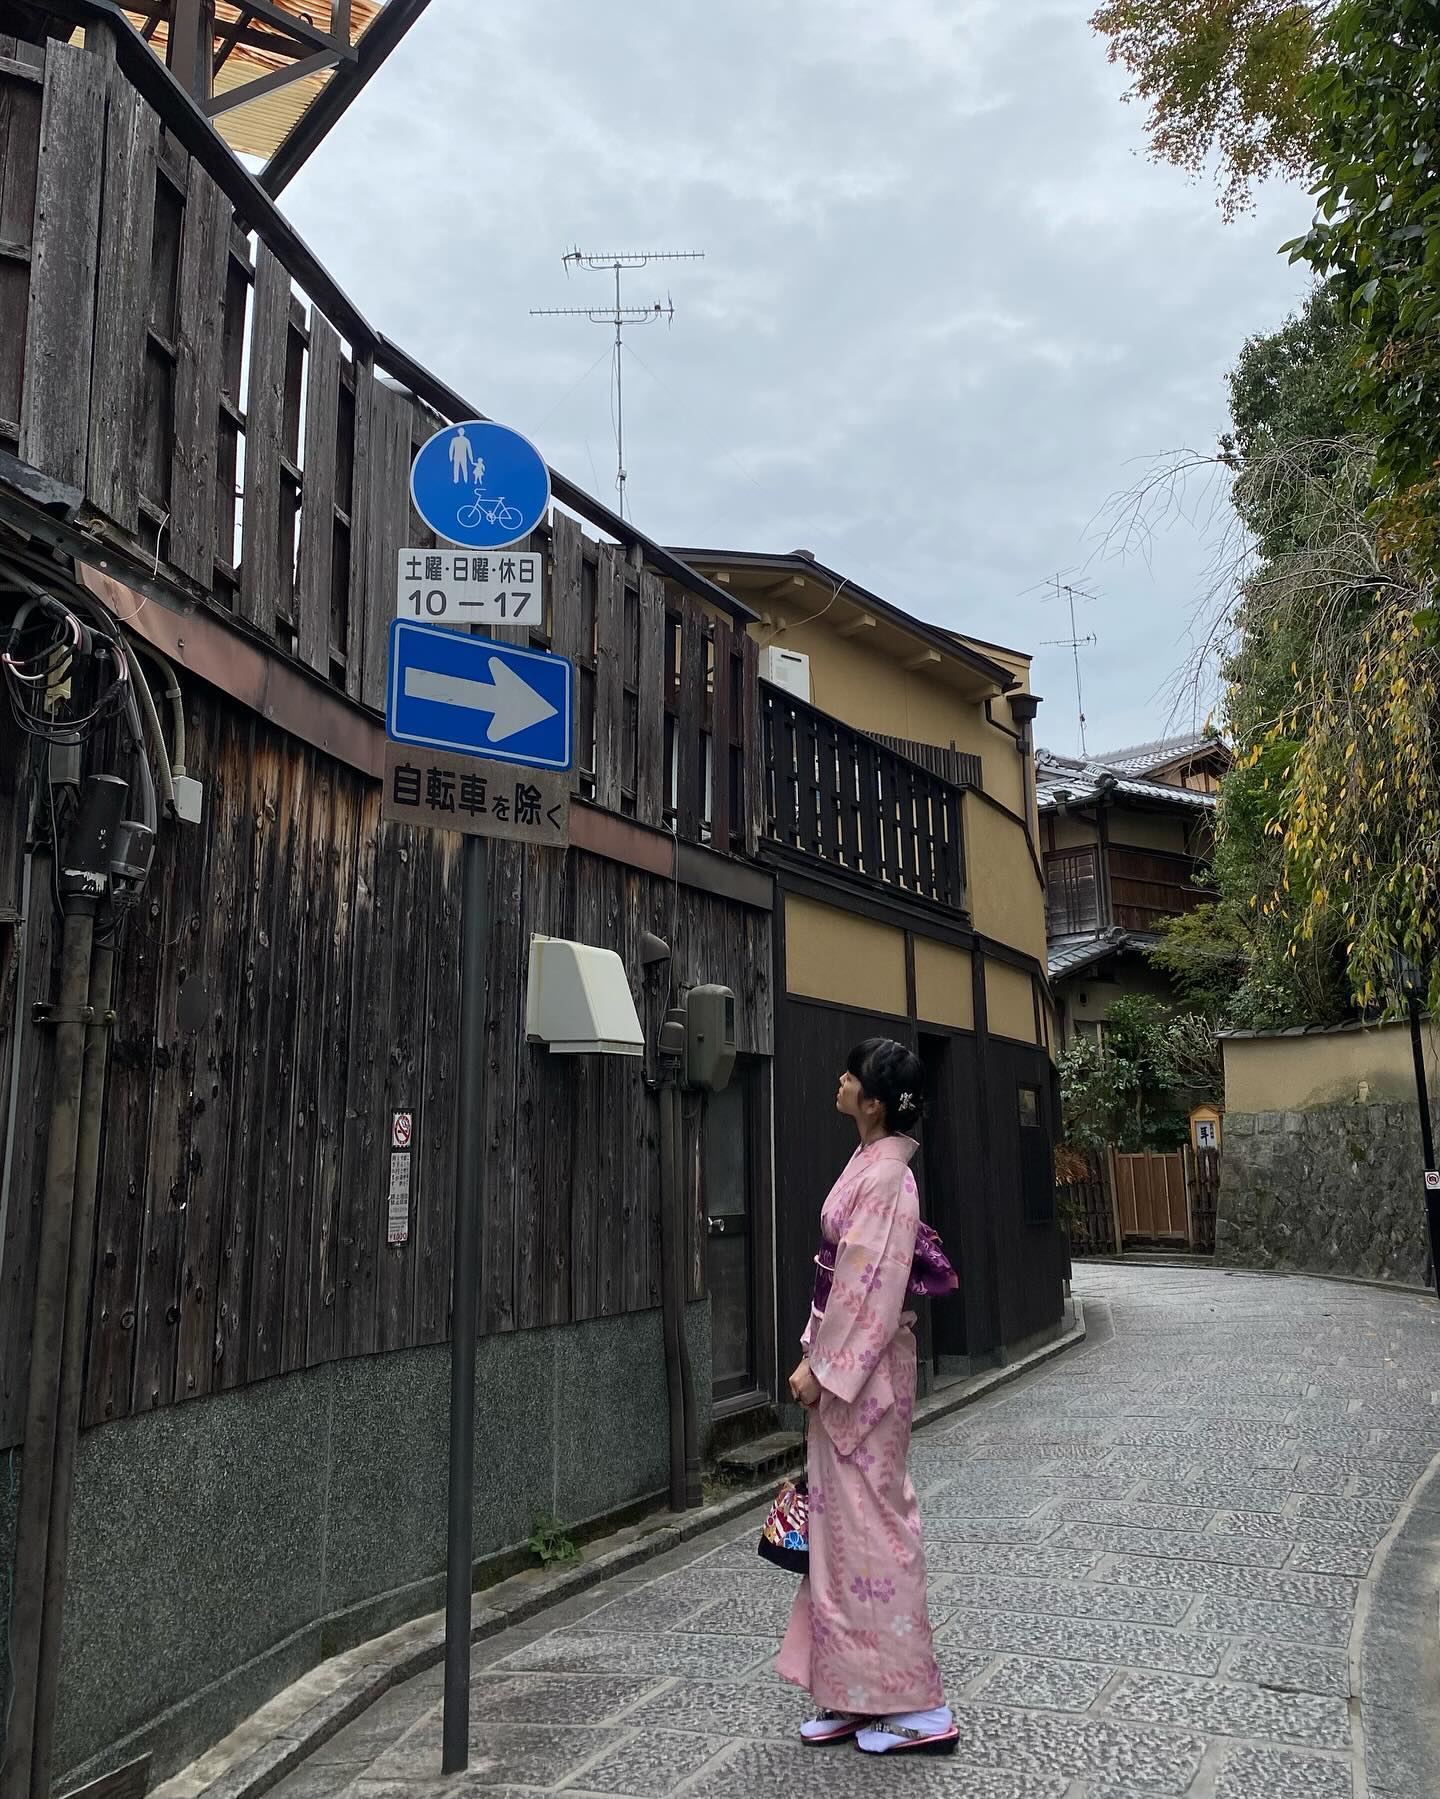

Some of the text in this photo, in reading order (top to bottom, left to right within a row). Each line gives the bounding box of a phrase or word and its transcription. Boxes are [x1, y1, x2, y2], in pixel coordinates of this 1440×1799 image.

[405, 557, 534, 583] 土曜・日曜・休日
[394, 764, 561, 831] 自転車を除く
